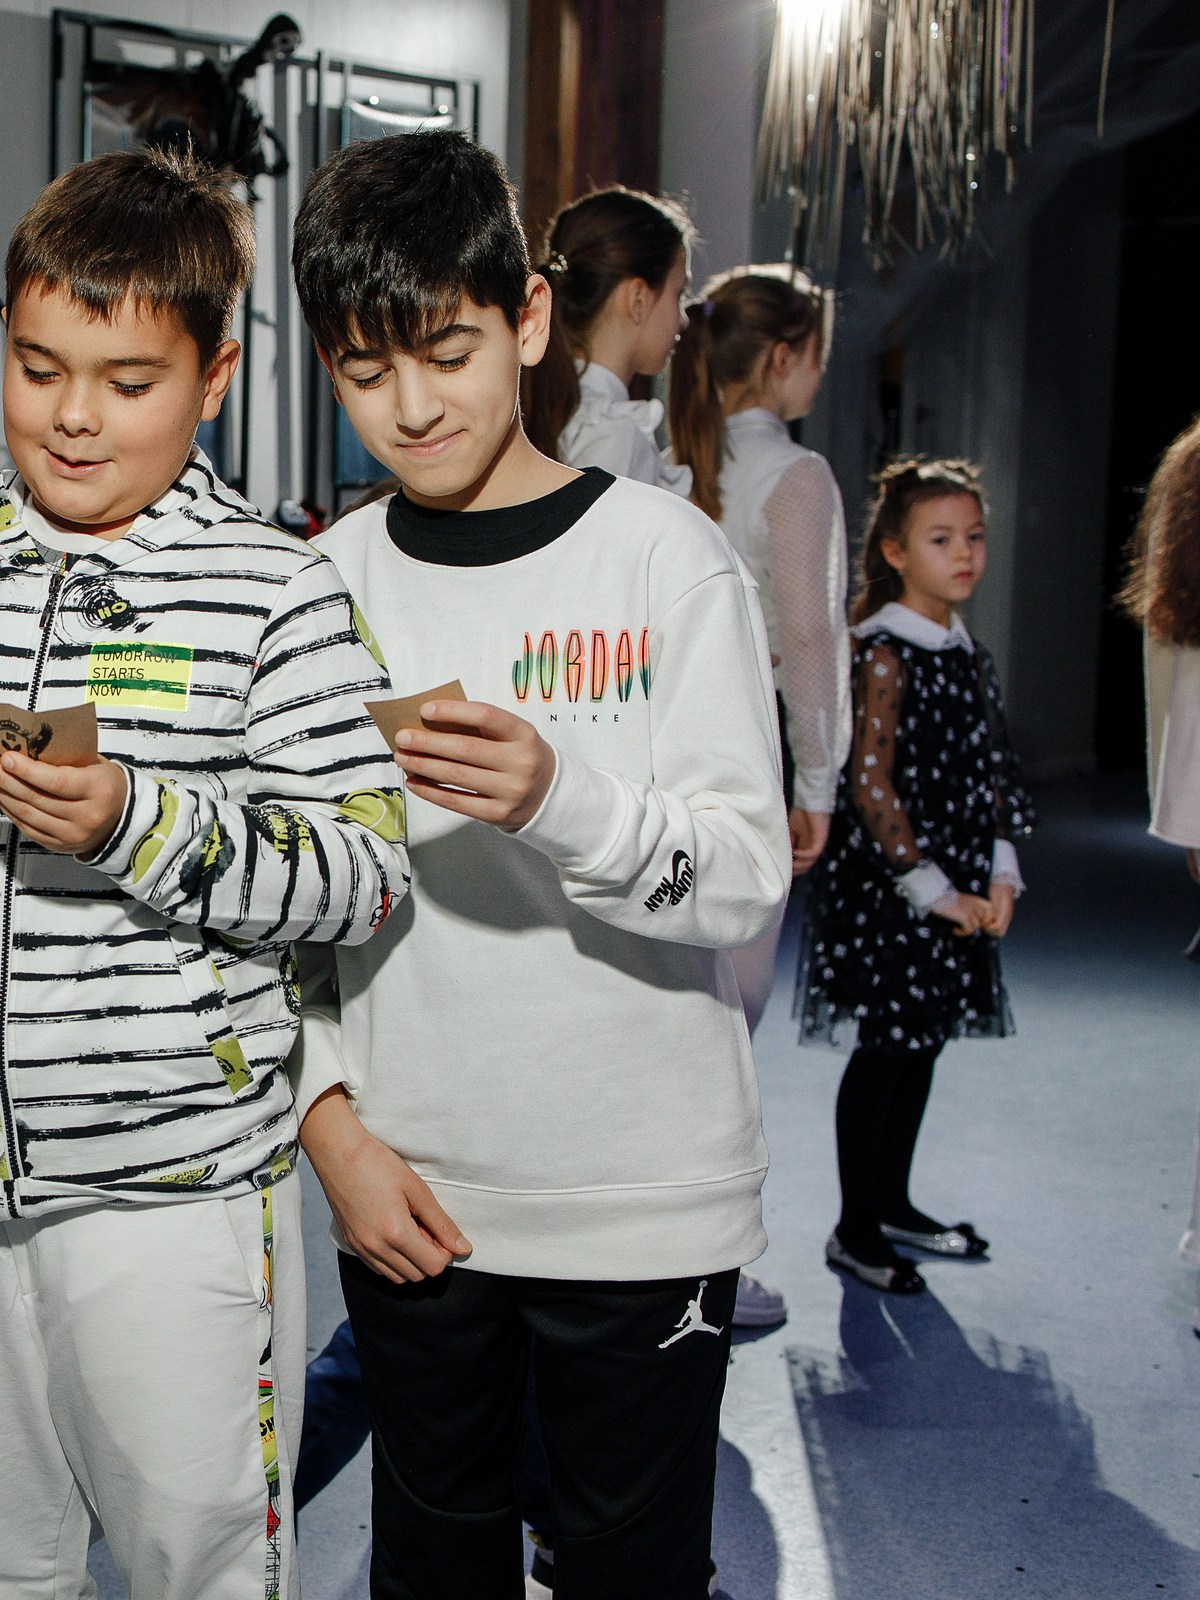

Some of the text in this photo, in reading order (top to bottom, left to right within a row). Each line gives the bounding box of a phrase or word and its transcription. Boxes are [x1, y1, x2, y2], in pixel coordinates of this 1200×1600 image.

[94, 649, 178, 663] TOMORROW
[92, 667, 145, 680] STARTS
[89, 685, 123, 697] NOW
[550, 713, 619, 723] NIKE
